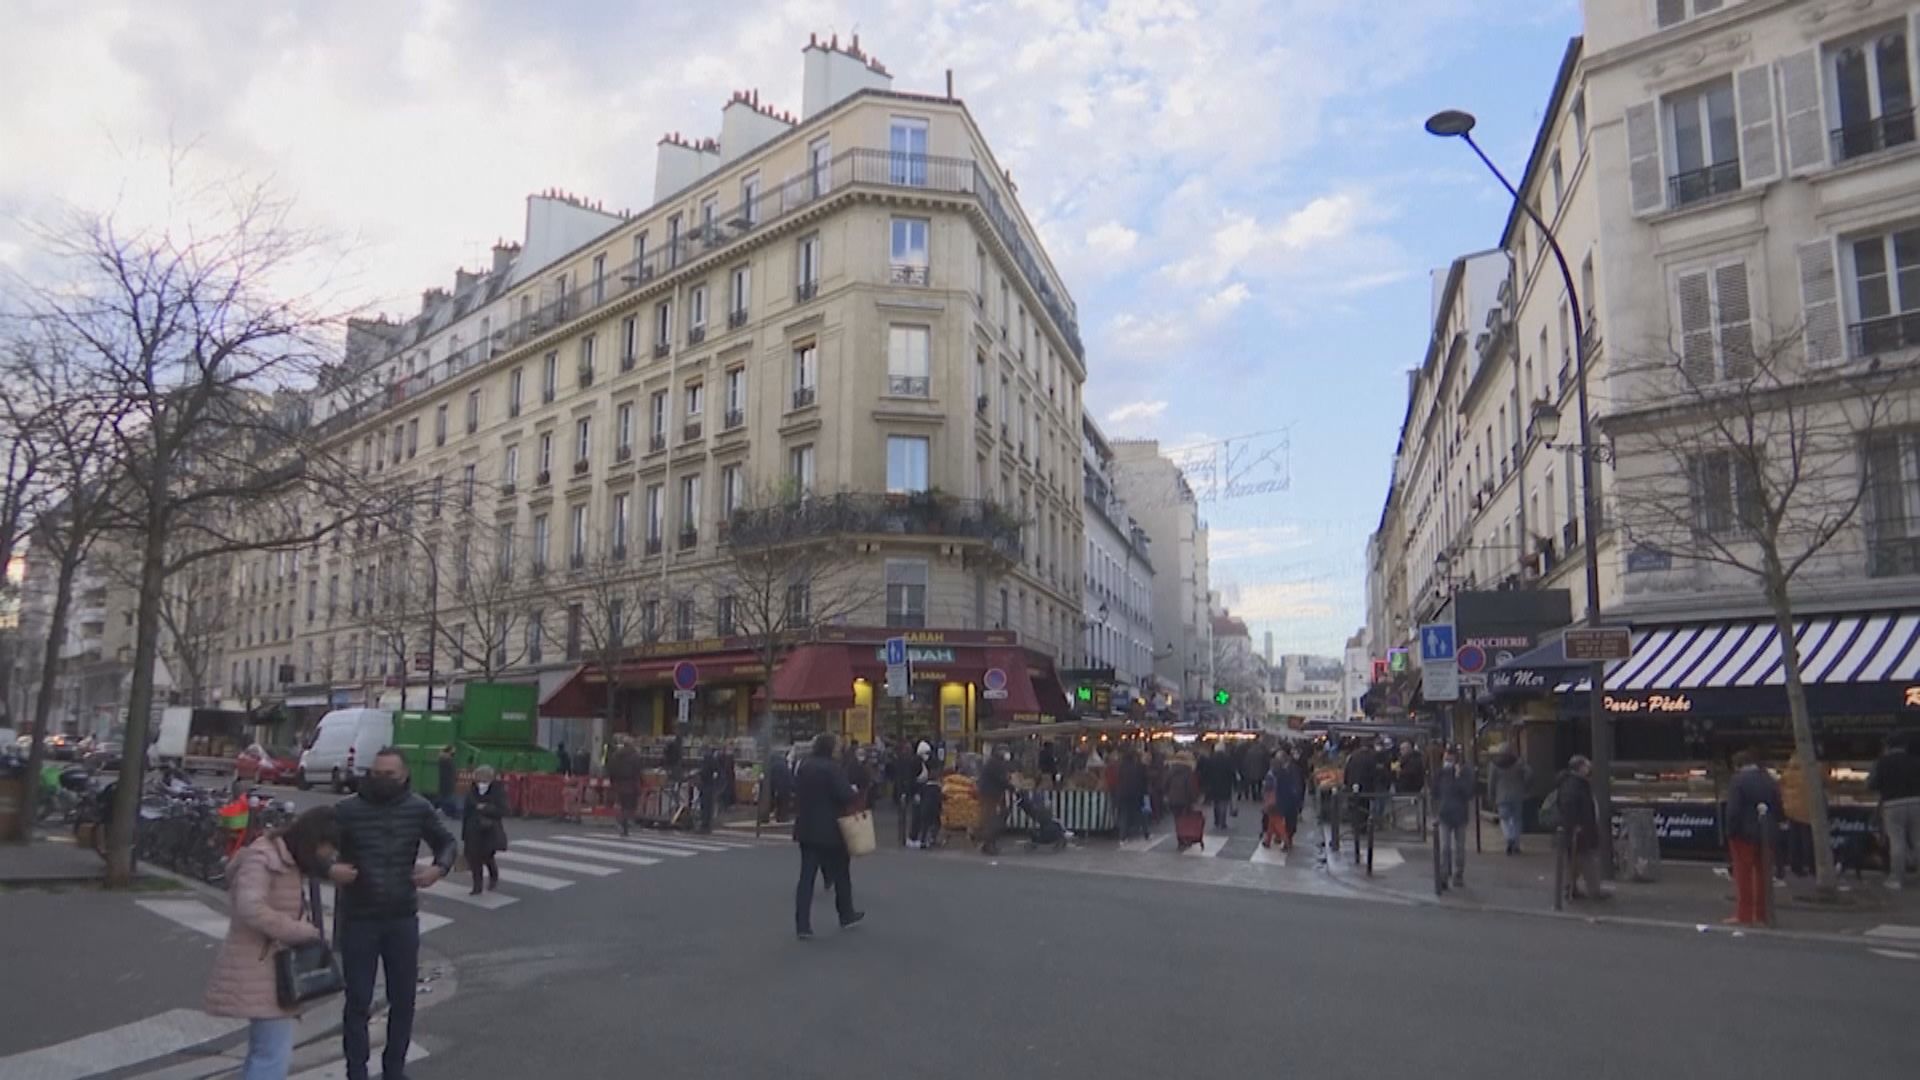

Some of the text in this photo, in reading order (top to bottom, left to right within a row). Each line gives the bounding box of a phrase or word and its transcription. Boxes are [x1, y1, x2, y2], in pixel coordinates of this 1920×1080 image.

[904, 632, 945, 643] SABAH
[1466, 636, 1529, 648] BOUCHERIE
[878, 649, 953, 662] SBAH
[1665, 814, 1714, 829] poissons
[1669, 828, 1693, 838] mer
